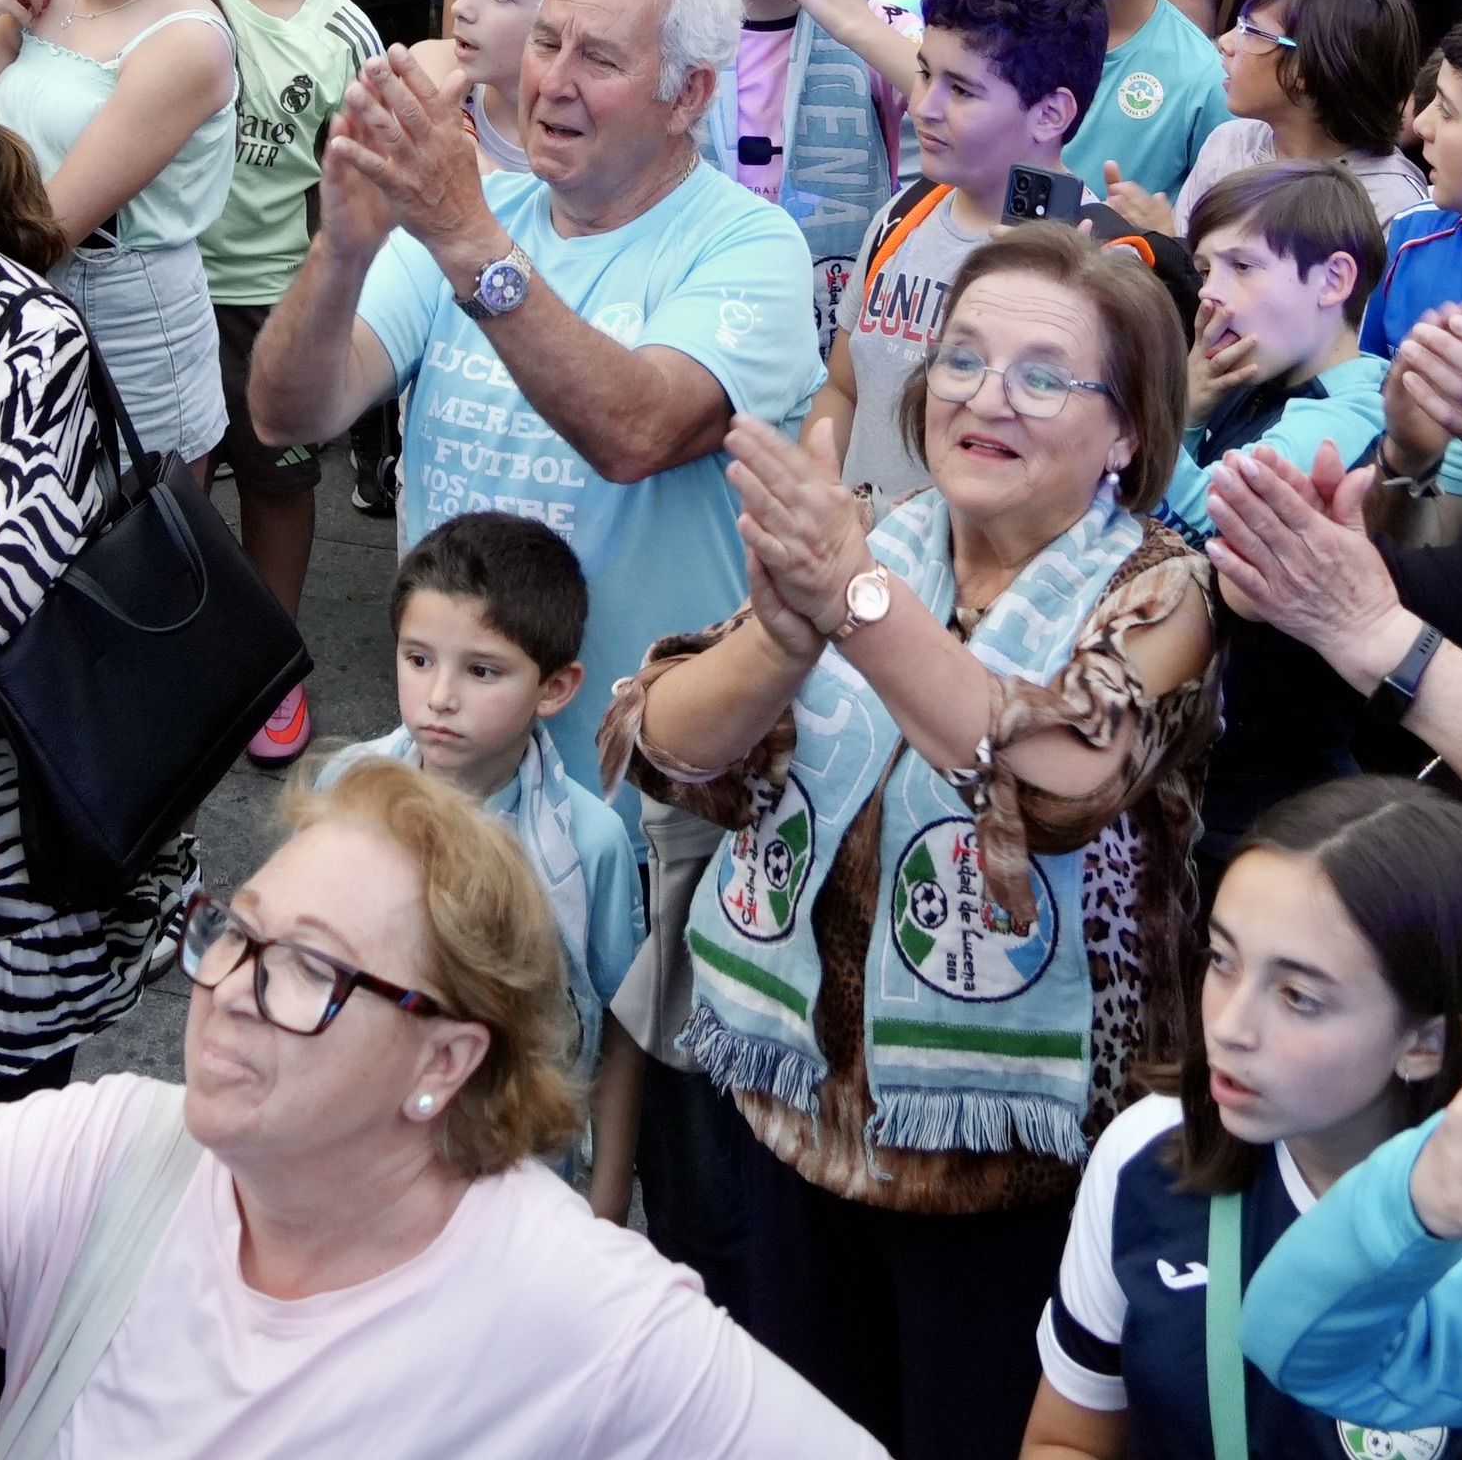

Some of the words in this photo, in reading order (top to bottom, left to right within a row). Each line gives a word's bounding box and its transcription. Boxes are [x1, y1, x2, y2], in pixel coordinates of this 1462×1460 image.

[239, 114, 296, 144] ates
[791, 58, 879, 228] CENA
[865, 271, 952, 329] UNIT
[426, 340, 517, 390] LUCE
[433, 439, 585, 488] FÚTBOL
